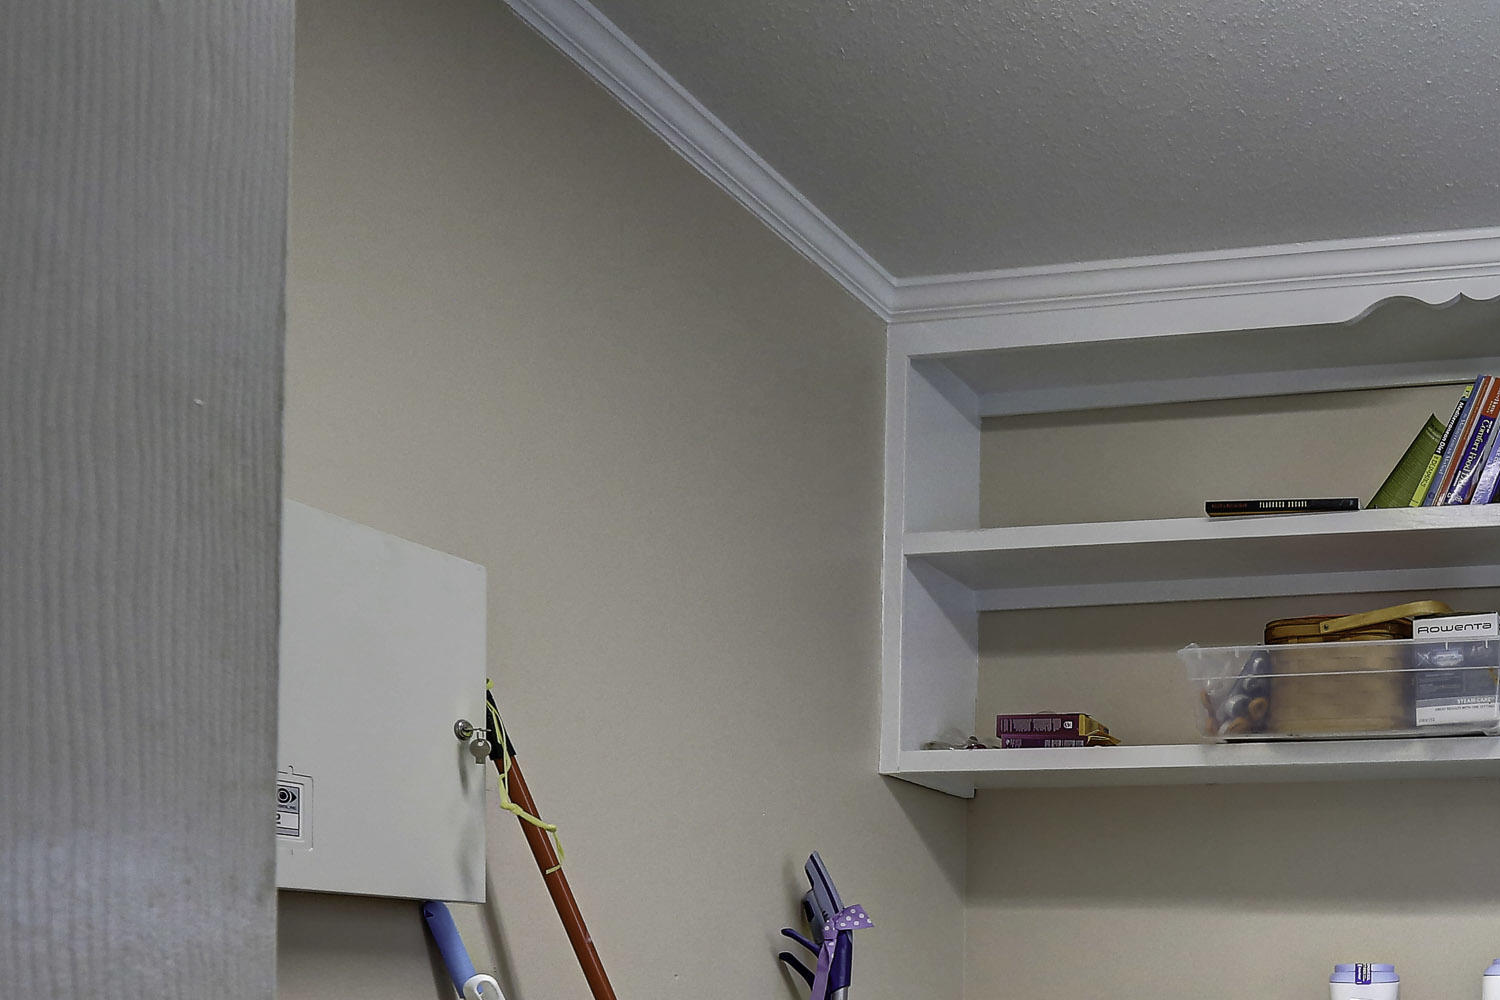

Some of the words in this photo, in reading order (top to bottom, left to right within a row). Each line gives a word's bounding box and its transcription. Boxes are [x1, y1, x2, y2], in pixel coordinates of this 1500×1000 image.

[1472, 419, 1490, 452] Comfort
[1436, 441, 1446, 454] Diet
[1463, 451, 1477, 473] Food
